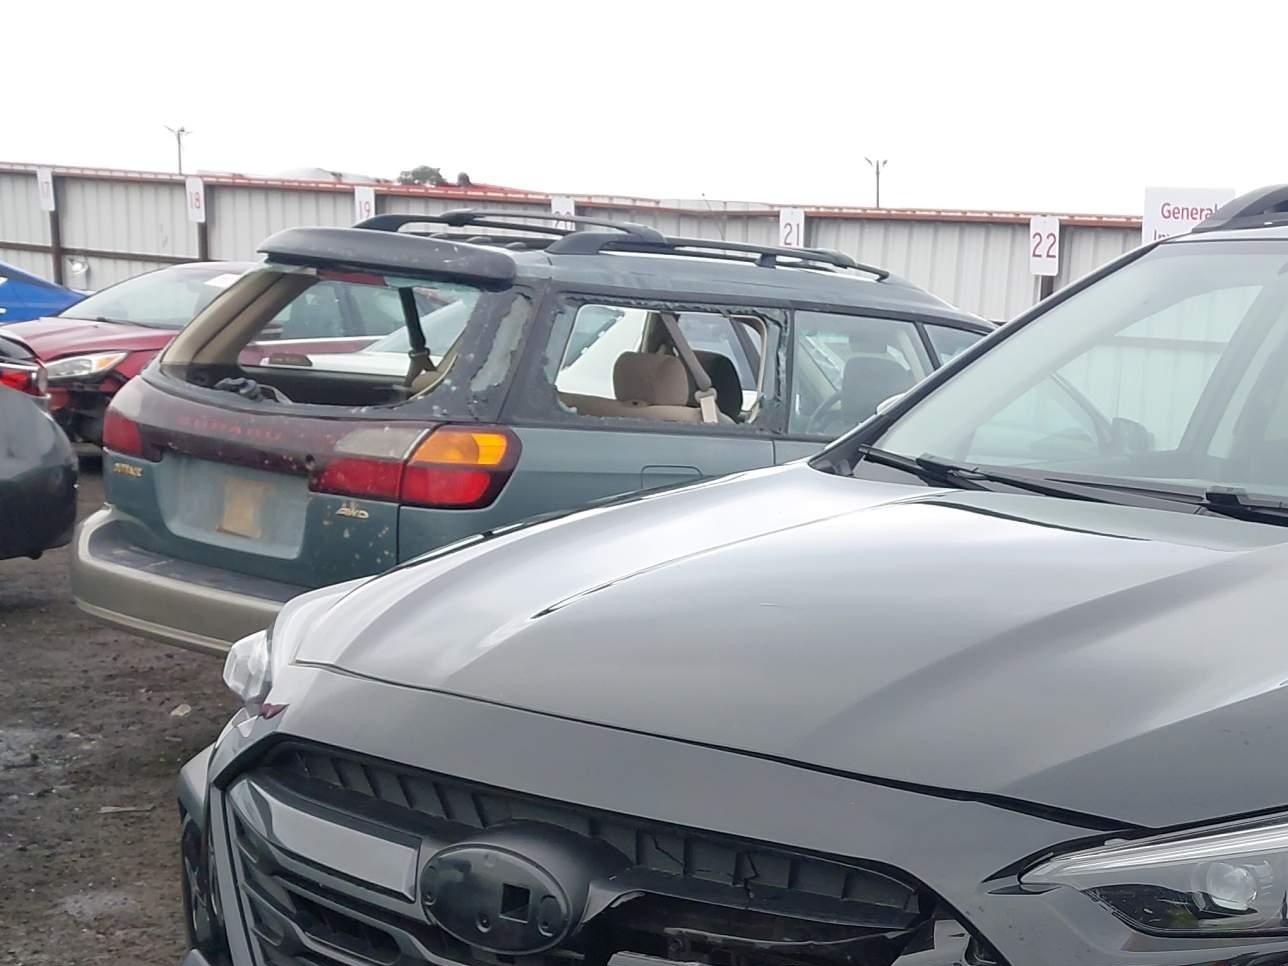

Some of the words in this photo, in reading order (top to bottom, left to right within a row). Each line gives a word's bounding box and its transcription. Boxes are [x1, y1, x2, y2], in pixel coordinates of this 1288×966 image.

[189, 191, 201, 209] 18
[359, 200, 371, 218] 19
[784, 222, 799, 246] 21
[1031, 232, 1057, 258] 22
